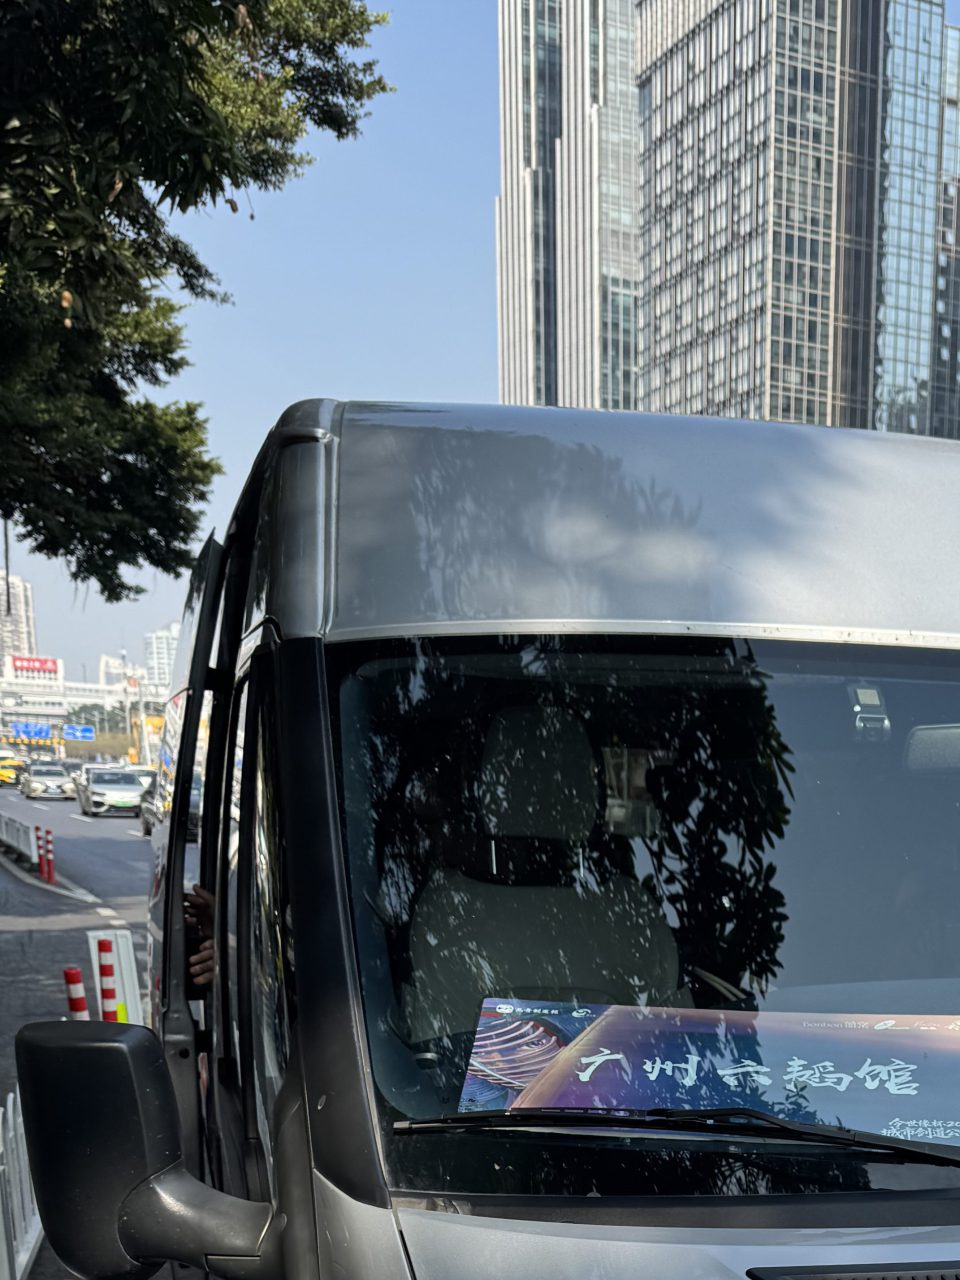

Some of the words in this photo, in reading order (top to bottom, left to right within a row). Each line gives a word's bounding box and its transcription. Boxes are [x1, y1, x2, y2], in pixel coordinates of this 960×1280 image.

[575, 1047, 920, 1095] 广州六韬馆
